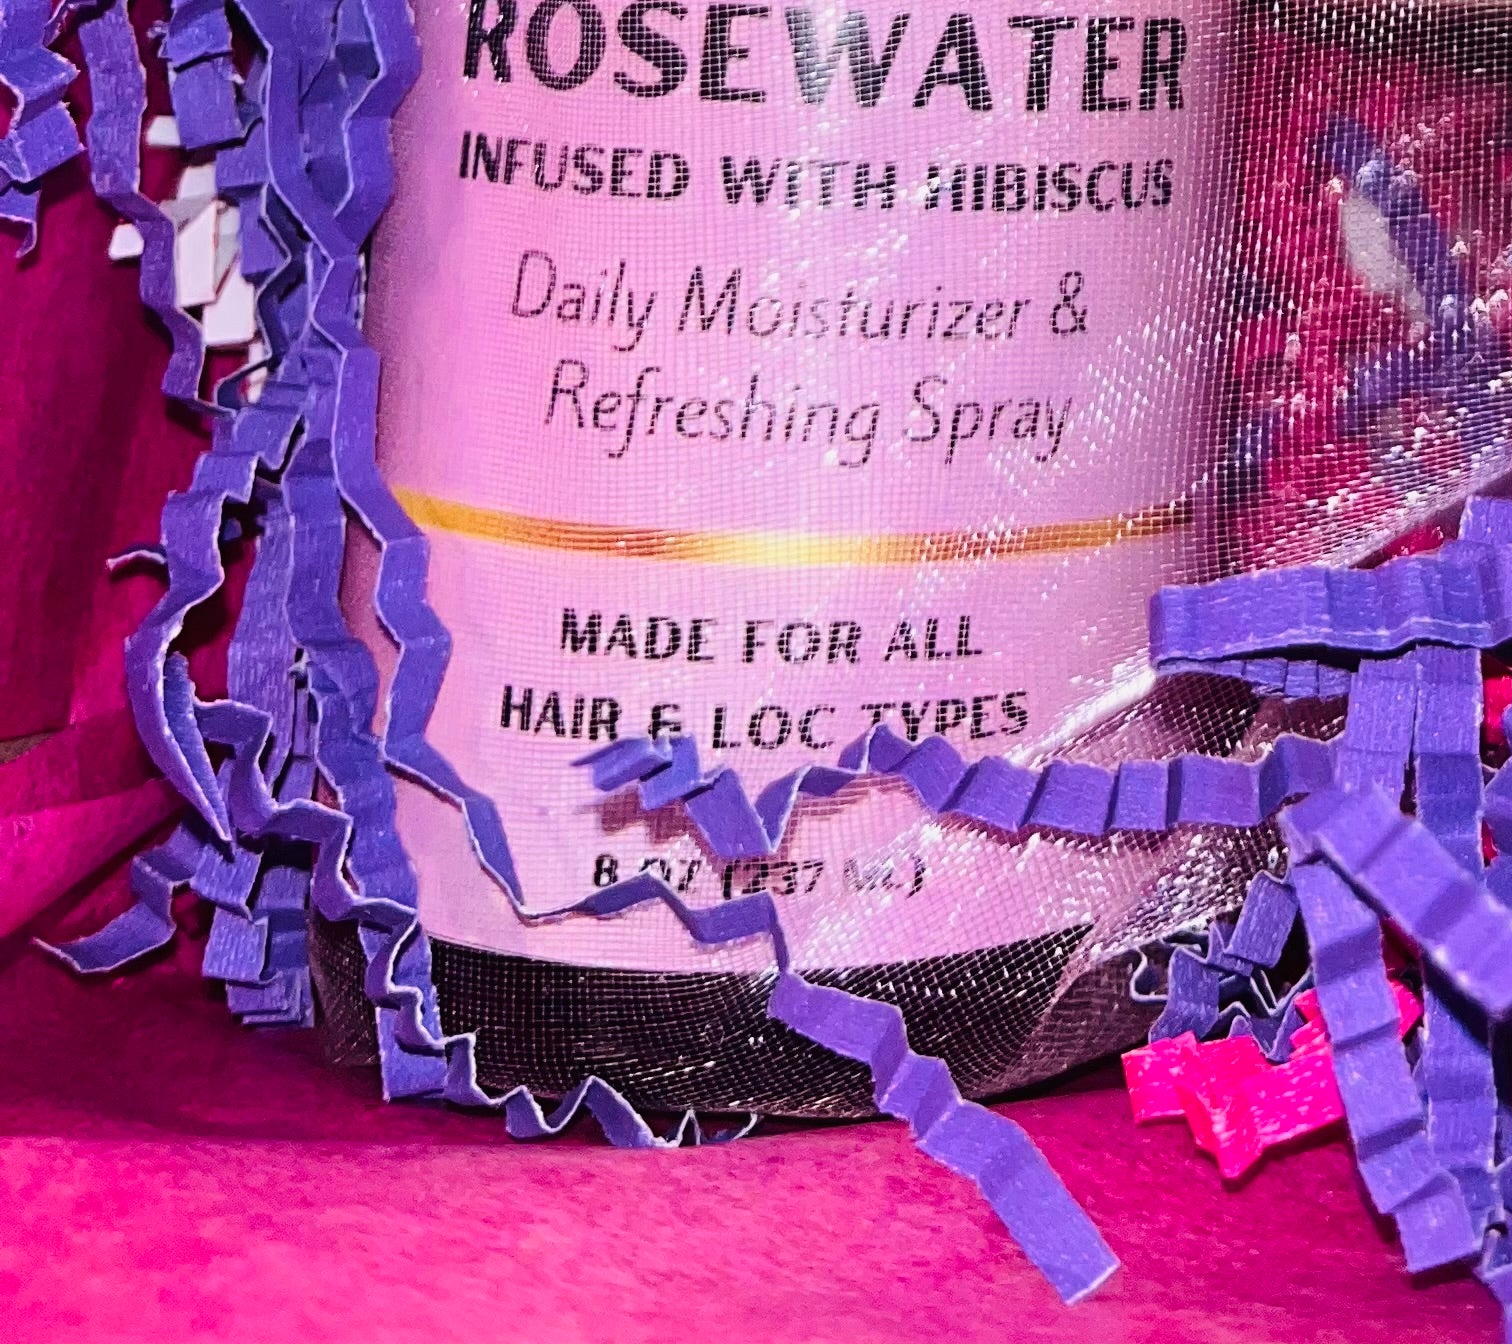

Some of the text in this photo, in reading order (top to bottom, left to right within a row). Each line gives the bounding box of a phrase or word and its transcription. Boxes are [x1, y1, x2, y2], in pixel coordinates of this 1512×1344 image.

[458, 129, 1175, 214] INFUSED WITH HIBISCUS
[511, 250, 1090, 352] Daily Moisturizer &
[544, 358, 1073, 468] Refreshing Spray
[560, 607, 983, 666] MADE FOR ALL
[499, 684, 622, 741] HAIR
[710, 704, 837, 751] LOC
[860, 689, 1030, 741] TYPES
[594, 854, 619, 889] 8
